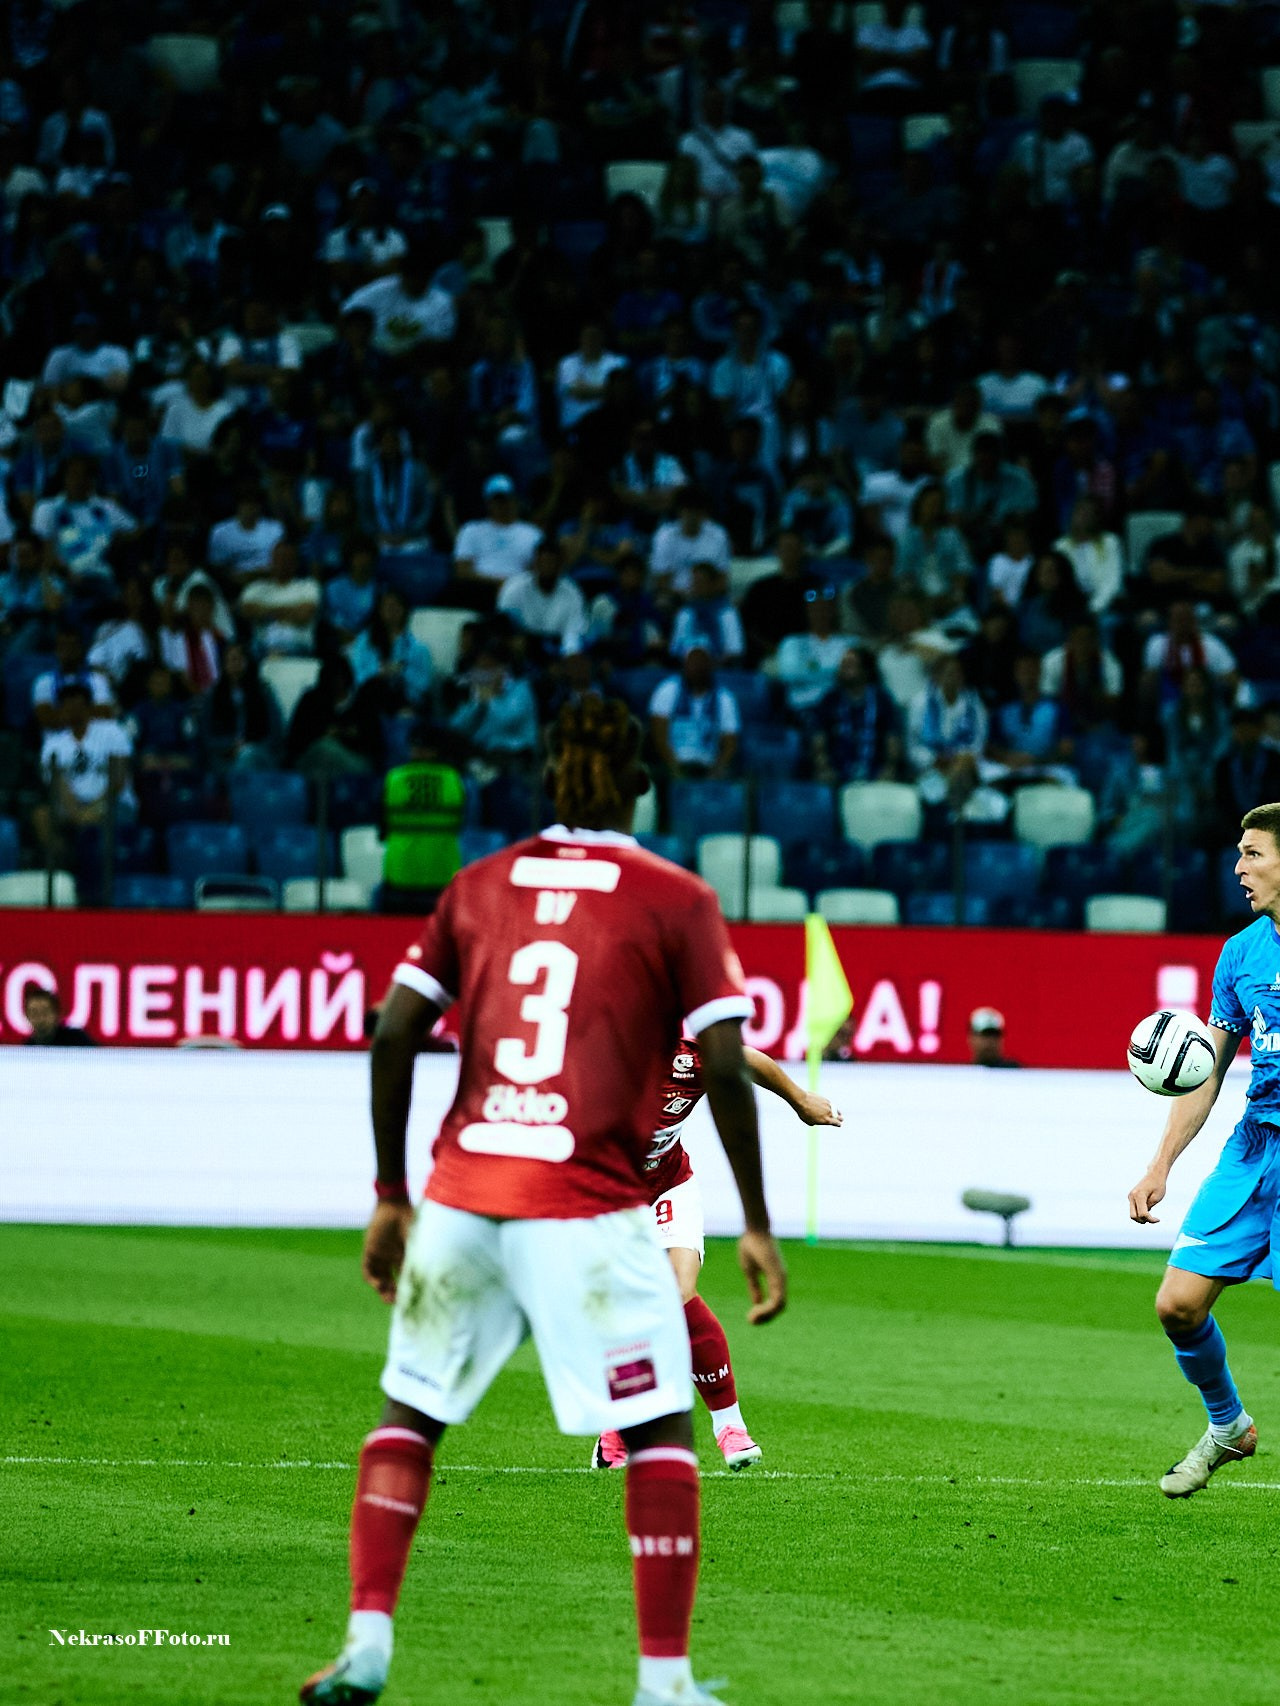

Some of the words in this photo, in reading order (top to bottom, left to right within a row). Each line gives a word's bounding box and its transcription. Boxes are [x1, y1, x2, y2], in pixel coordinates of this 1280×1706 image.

[0, 950, 366, 1042] ОЛЕНИЙ
[494, 939, 579, 1085] 3
[655, 1199, 673, 1226] 9
